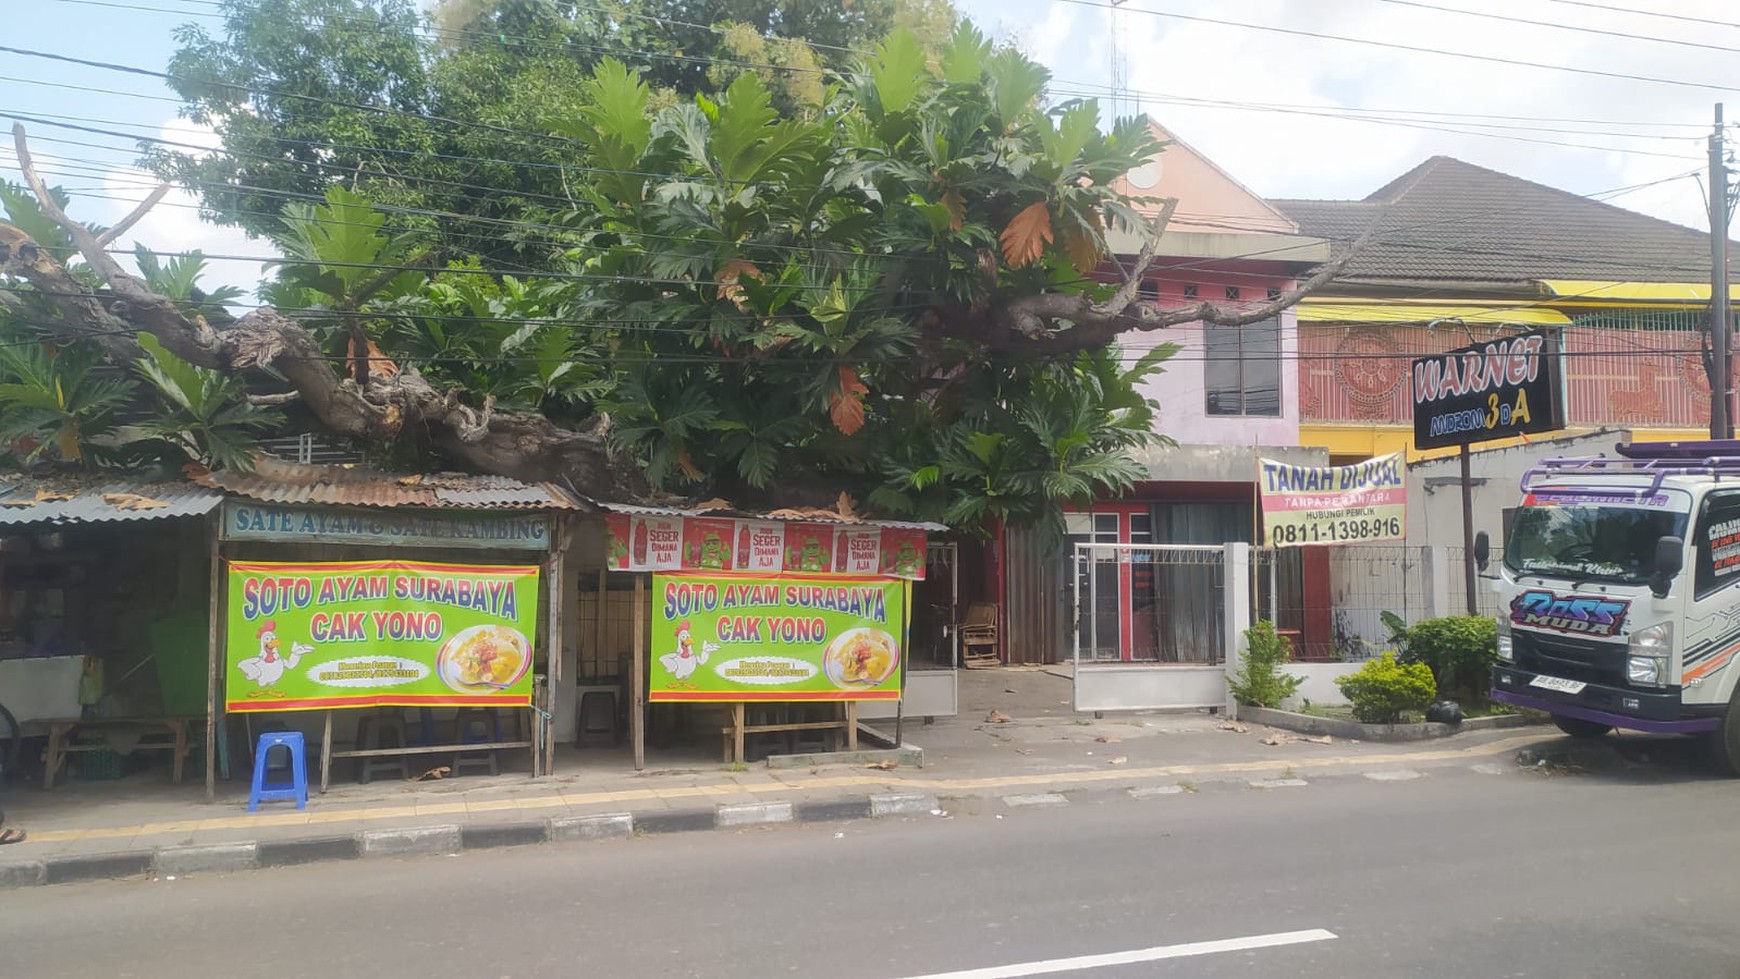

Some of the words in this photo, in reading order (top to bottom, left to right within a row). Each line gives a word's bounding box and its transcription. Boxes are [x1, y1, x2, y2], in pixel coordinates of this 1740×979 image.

[1415, 335, 1543, 403] WARNET
[1263, 464, 1334, 492] TANAH
[1340, 459, 1402, 490] DIJUAL
[1284, 496, 1322, 508] TANPA
[1306, 509, 1344, 520] HUBUNGI
[1346, 507, 1375, 517] PEMILIK
[236, 509, 294, 533] SATE
[300, 512, 363, 536] AYAM
[390, 514, 444, 538] SATE
[450, 517, 545, 540] KAMBING
[1273, 518, 1400, 544] 0811-1398-916
[650, 530, 679, 542] SEGER
[753, 534, 781, 547] SEGER
[651, 543, 678, 552] DIMANA
[850, 539, 877, 551] SEGER
[656, 553, 672, 563] AJA
[758, 557, 774, 567] AJA
[856, 561, 871, 571] AJA
[243, 576, 312, 620] SOTO
[317, 576, 388, 605] AYAM
[395, 576, 518, 621] SURABAYA
[664, 582, 718, 620] SOTO
[723, 584, 779, 608] AYAM
[786, 585, 885, 623] SURABAYA
[311, 612, 366, 642] CAK
[372, 611, 443, 641] YONO
[717, 616, 761, 643] CAK
[767, 616, 827, 644] YONO
[1524, 614, 1612, 635] MUDA
